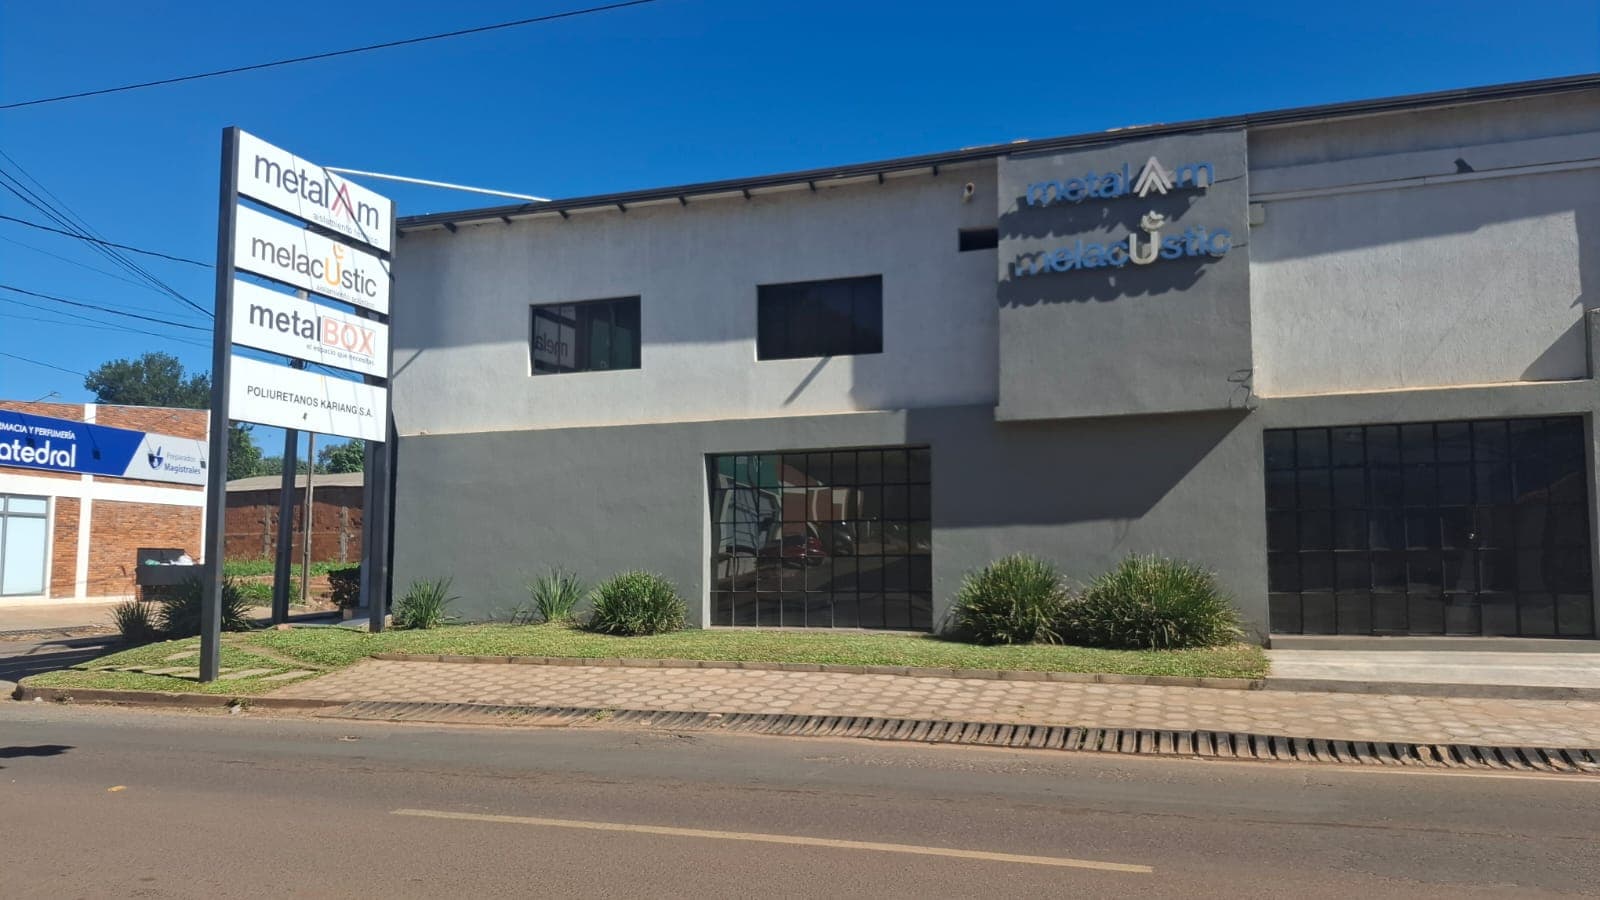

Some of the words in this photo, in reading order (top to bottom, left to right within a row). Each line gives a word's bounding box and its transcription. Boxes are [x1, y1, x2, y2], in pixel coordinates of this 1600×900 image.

[337, 351, 348, 359] que
[247, 385, 319, 408] POLIURETANOS
[320, 400, 358, 415] KARIANG
[359, 406, 374, 418] S.A.
[28, 426, 34, 434] Y
[0, 439, 76, 468] atedral
[164, 463, 201, 475] Magistrales
